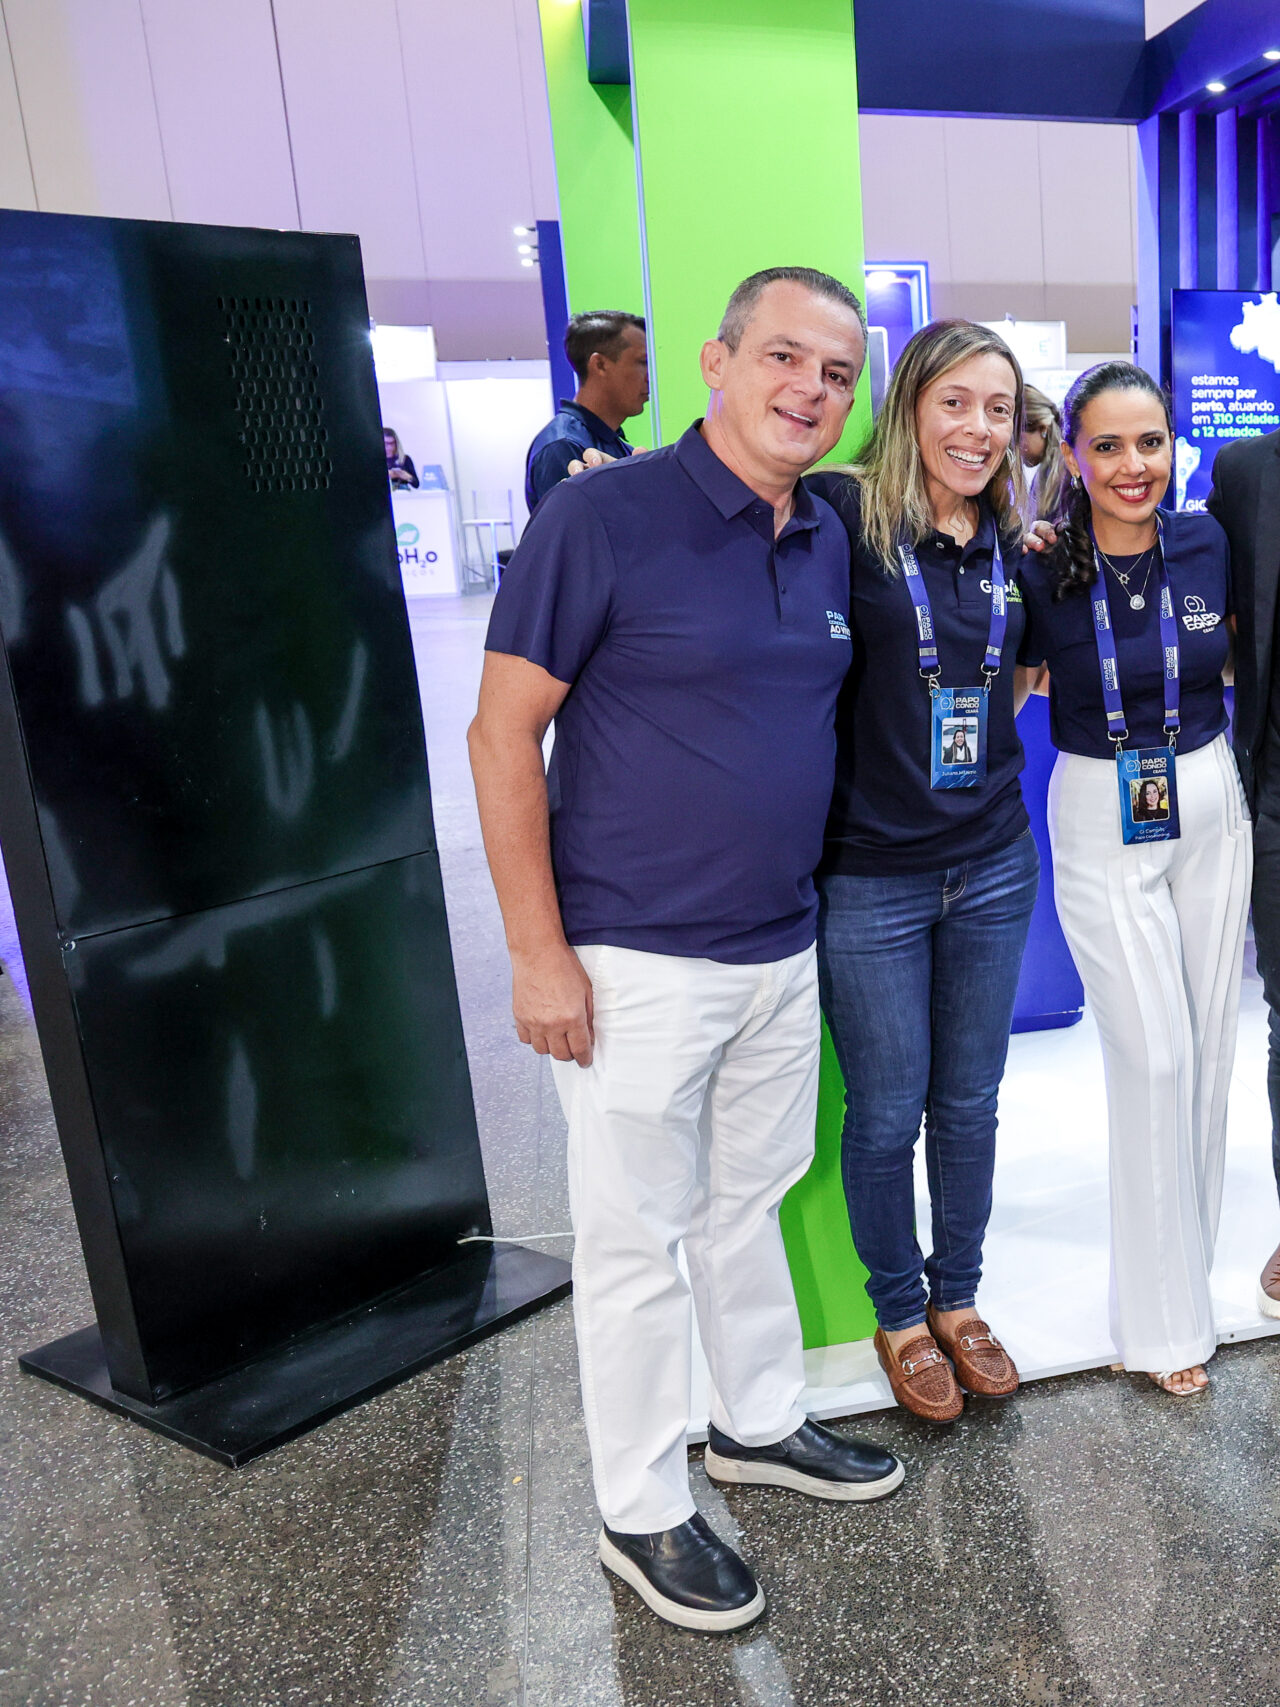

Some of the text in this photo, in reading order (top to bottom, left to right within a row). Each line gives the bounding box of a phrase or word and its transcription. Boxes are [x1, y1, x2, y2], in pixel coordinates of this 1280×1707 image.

[1191, 374, 1240, 386] estamos
[1191, 389, 1257, 400] sempre por
[1191, 400, 1275, 413] perto, atuando
[1191, 412, 1280, 424] em 310 cidades
[1191, 428, 1201, 437] e
[1202, 426, 1215, 437] 12
[1182, 613, 1221, 625] PAPO
[925, 616, 933, 640] PAPO
[1142, 757, 1167, 765] PAPO
